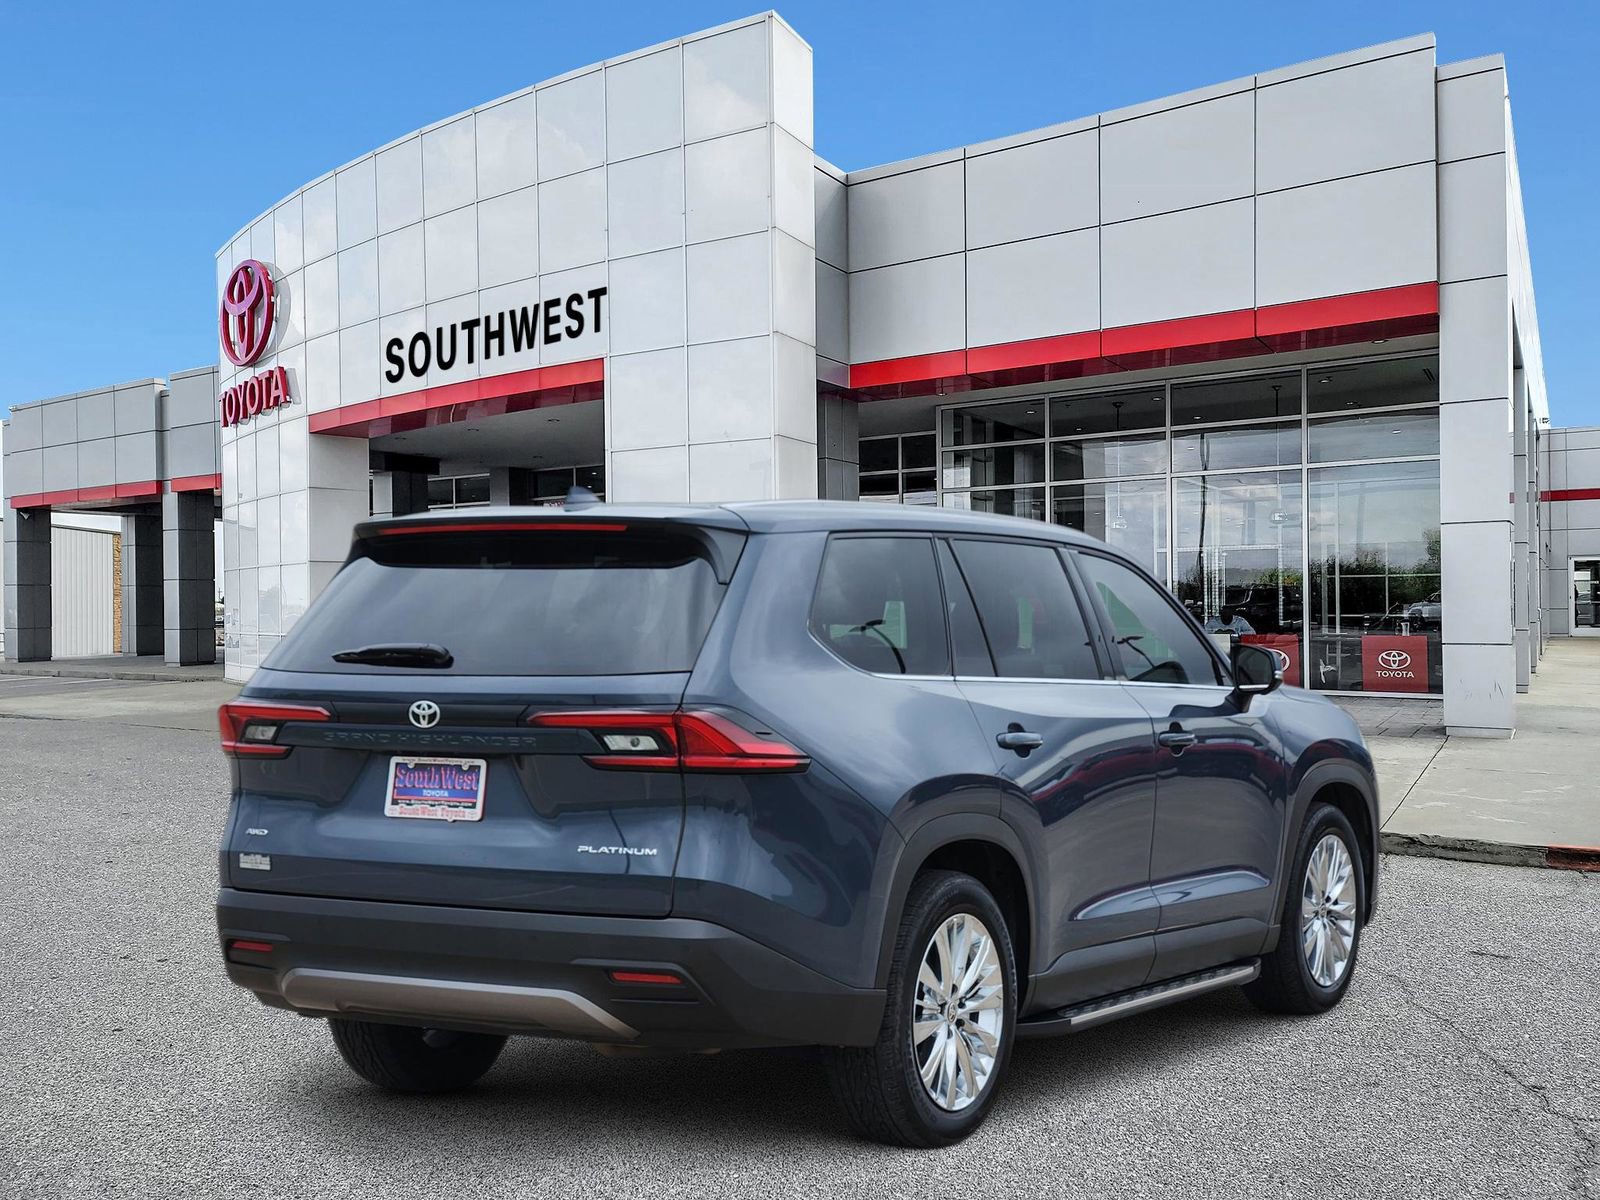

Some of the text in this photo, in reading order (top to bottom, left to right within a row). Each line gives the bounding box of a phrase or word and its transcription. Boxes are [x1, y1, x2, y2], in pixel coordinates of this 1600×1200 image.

[385, 287, 607, 383] SOUTHWEST
[219, 366, 290, 428] TOYOTA
[1375, 670, 1415, 678] TOYOTA
[423, 789, 449, 797] TOYOTA
[577, 845, 658, 856] PLATINUM
